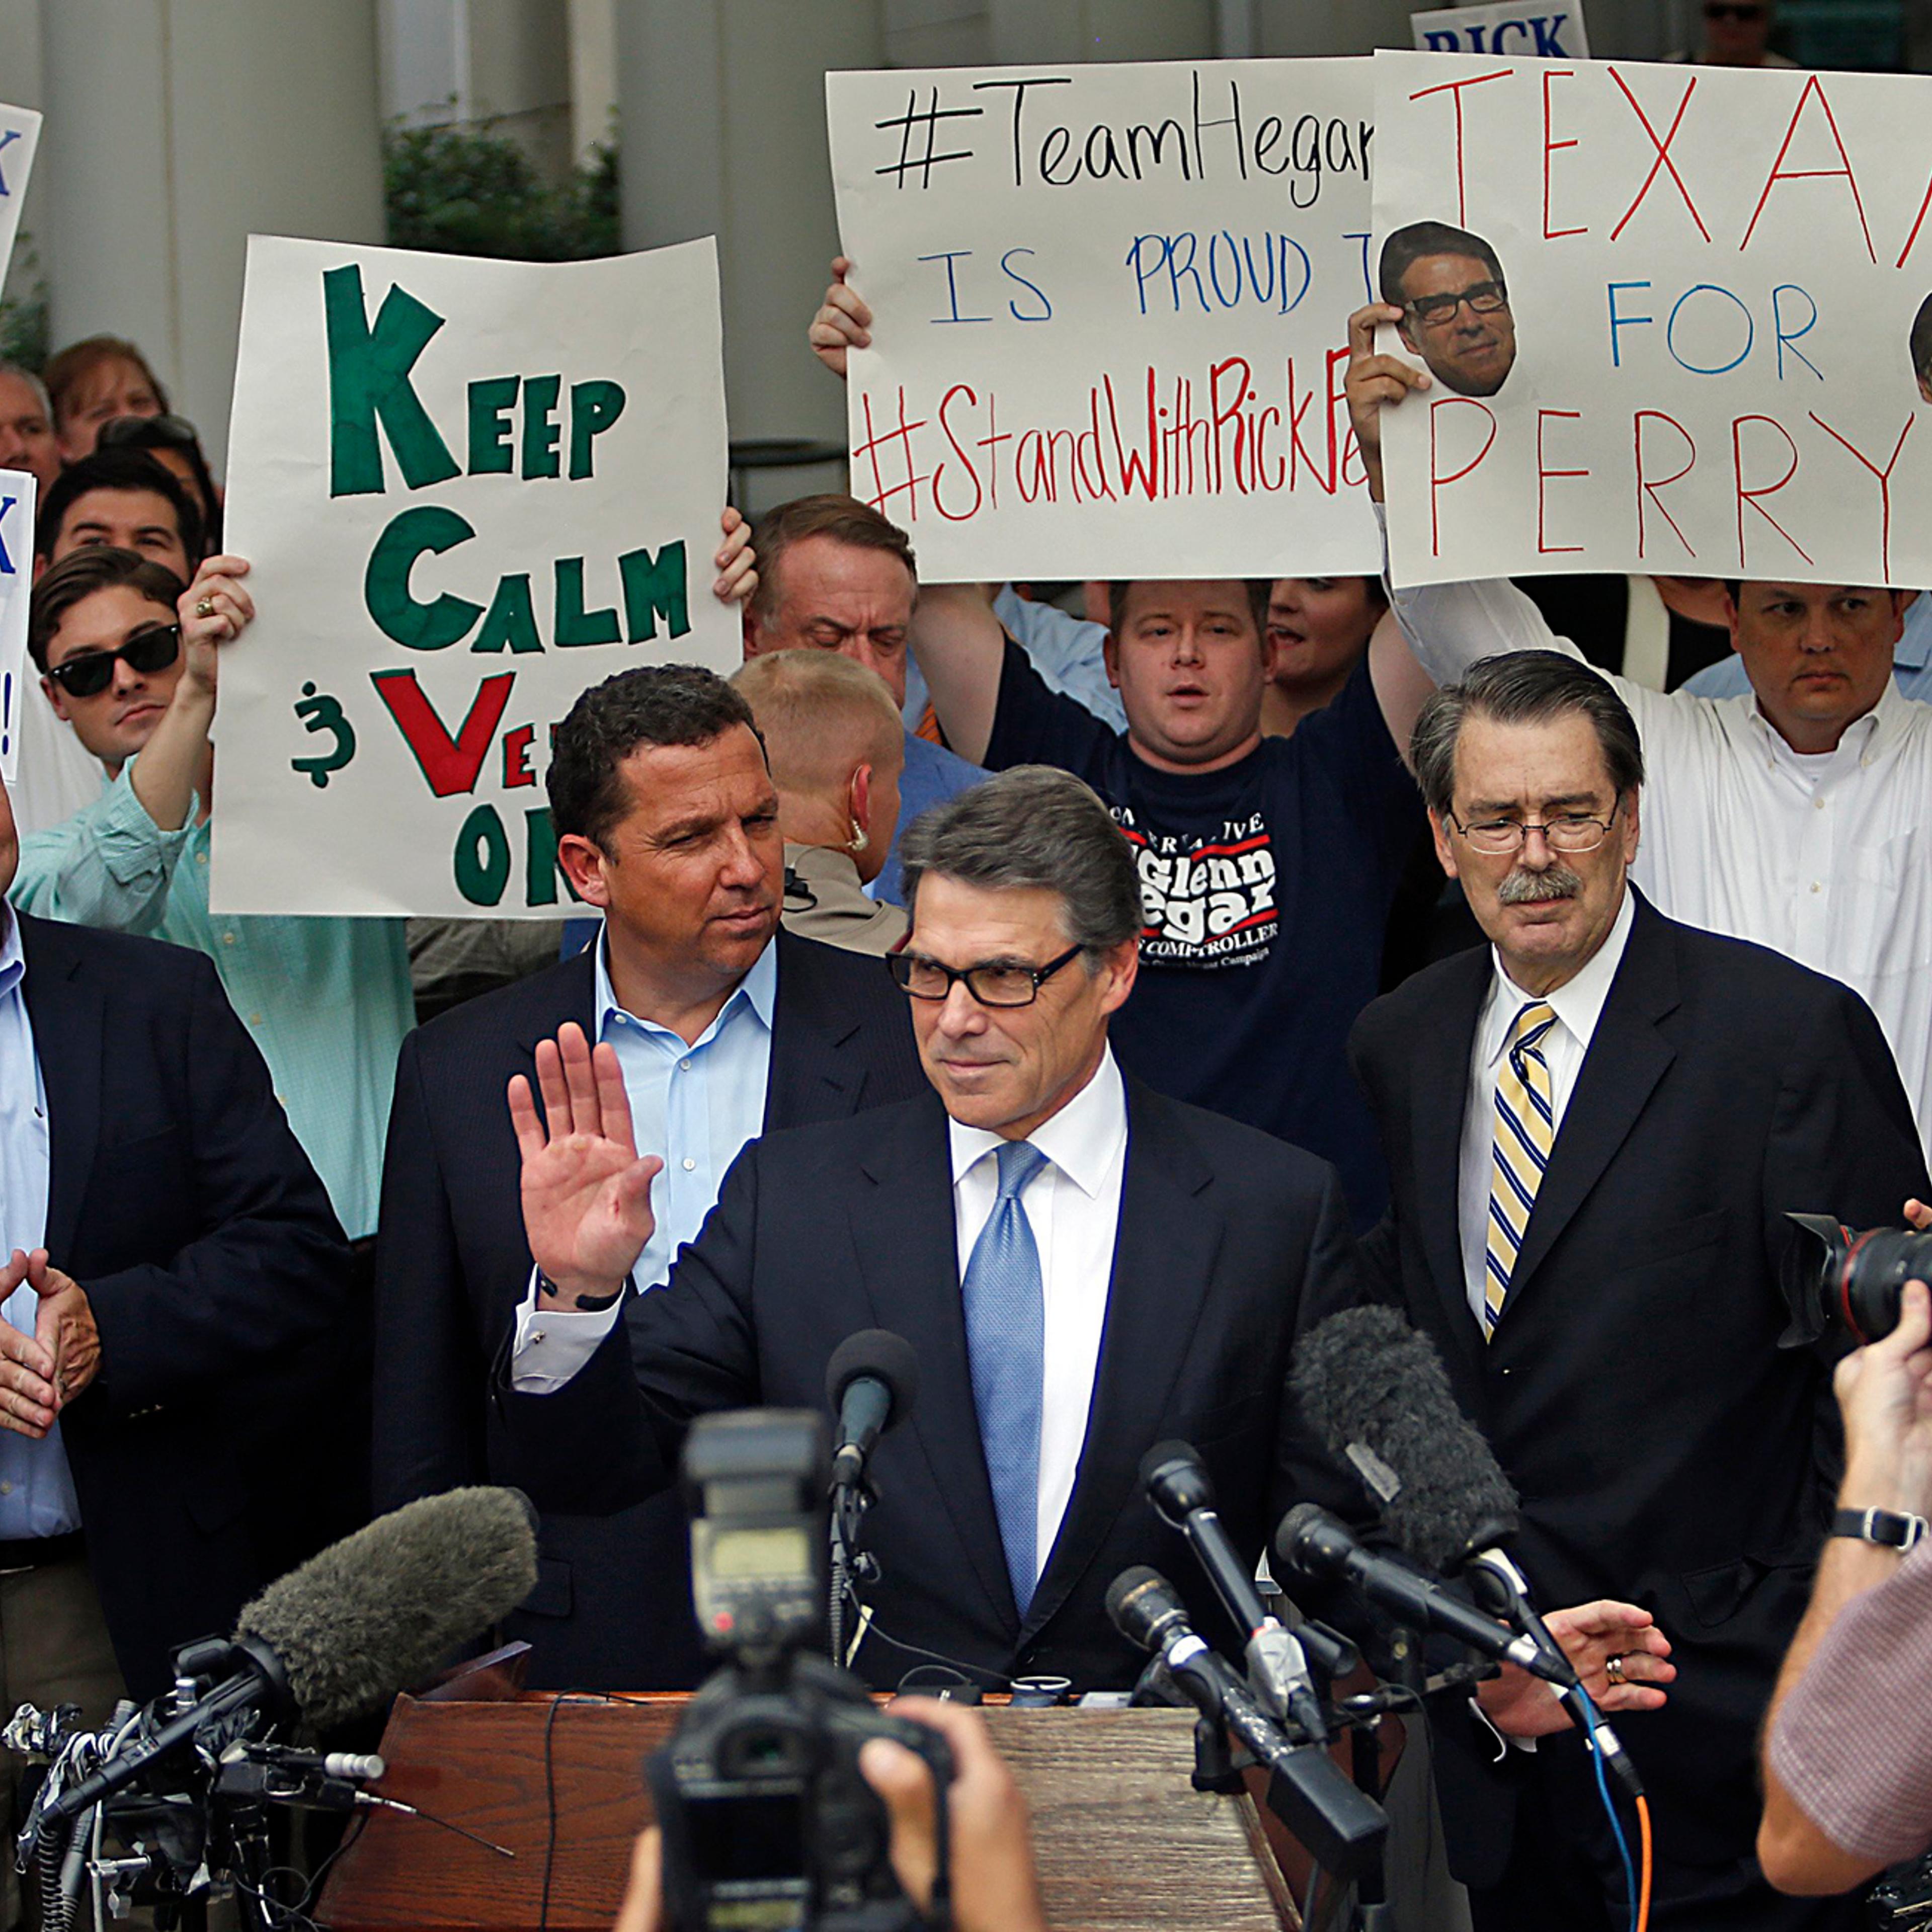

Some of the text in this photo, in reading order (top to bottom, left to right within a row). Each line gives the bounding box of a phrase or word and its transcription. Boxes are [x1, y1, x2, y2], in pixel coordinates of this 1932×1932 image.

[875, 69, 1375, 208] #TeamHegar
[1409, 66, 1932, 269] TEXA
[918, 248, 1053, 324] IS
[1125, 229, 1311, 315] PROUD
[1341, 232, 1373, 305] T
[1607, 283, 1824, 381] FOR
[323, 263, 626, 499] KEEP
[852, 345, 1370, 522] #StandWithRickPe
[1431, 397, 1916, 585] PERRY
[364, 505, 692, 654] CALM
[369, 667, 564, 798] VE
[1138, 849, 1275, 898] Glenn
[1141, 874, 1276, 945] egar
